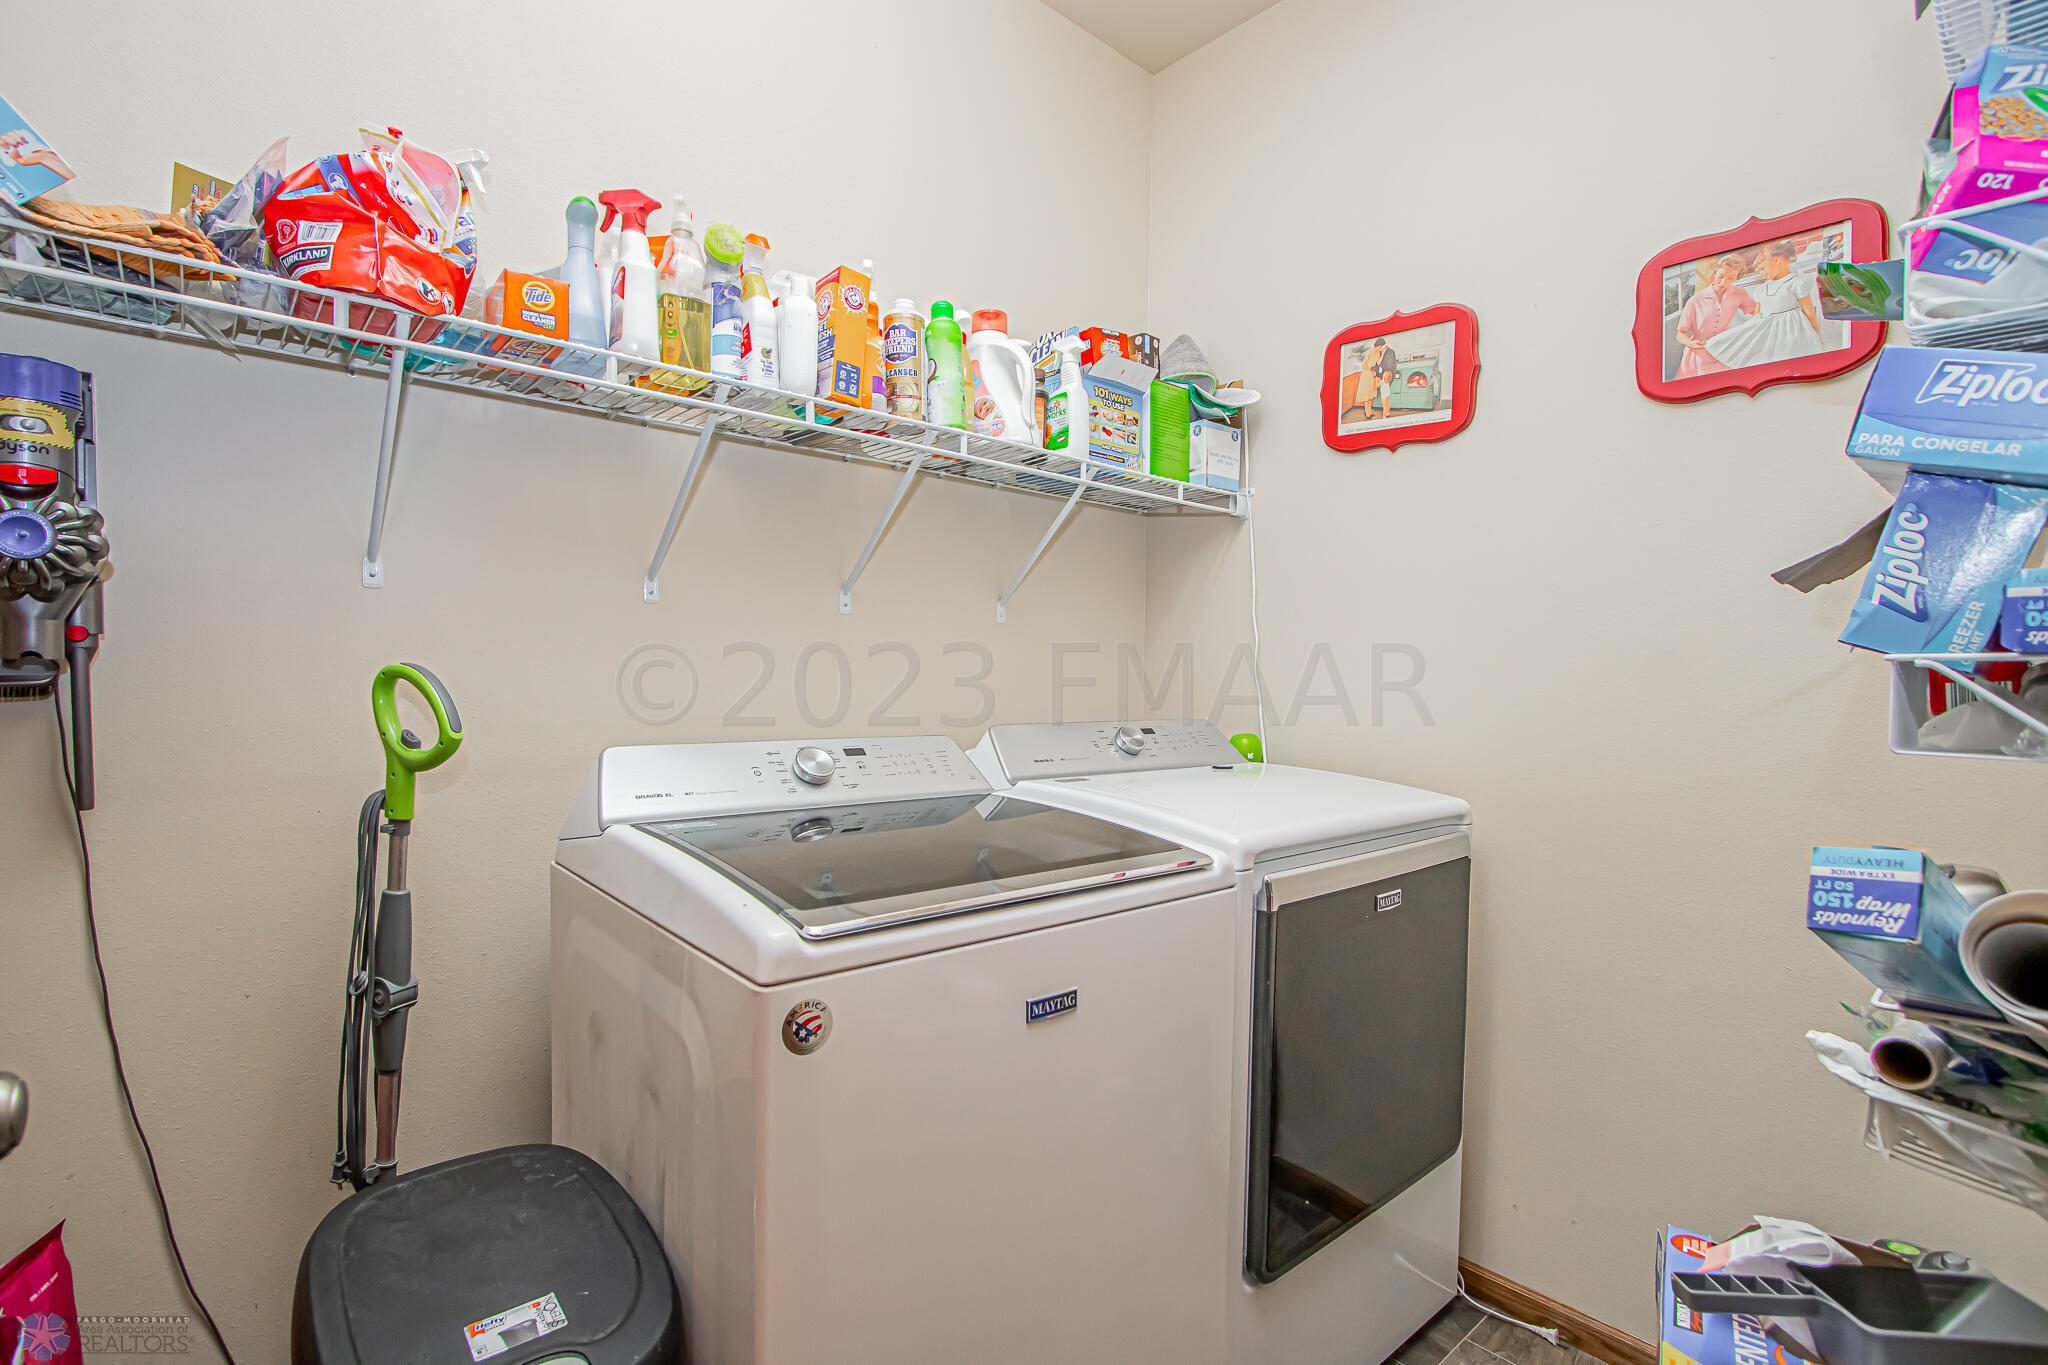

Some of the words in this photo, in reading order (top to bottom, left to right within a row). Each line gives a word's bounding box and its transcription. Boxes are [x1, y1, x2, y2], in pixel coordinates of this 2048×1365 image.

[1977, 173, 2014, 190] 120
[282, 248, 328, 268] KIRKLAND
[525, 287, 552, 303] Tide
[889, 328, 907, 338] BAR
[1930, 363, 2048, 408] Ziploc
[1093, 385, 1109, 399] 101
[1110, 392, 1133, 406] WAYS
[1102, 399, 1112, 407] TO
[1113, 403, 1125, 411] USE
[1854, 443, 1901, 457] GALÓN
[1858, 432, 1905, 448] PARA
[1911, 435, 2022, 457] CONGELAR
[1871, 511, 1930, 616] Ziploc
[1948, 600, 1985, 655] REEZER
[1814, 879, 1831, 889] FT
[1833, 880, 1854, 891] SQ
[1379, 894, 1400, 907] MAYTAG
[1812, 890, 1855, 908] 150
[1855, 895, 1911, 919] Wrap
[1811, 911, 1904, 934] Reynolds
[1031, 994, 1076, 1017] MAYTAG
